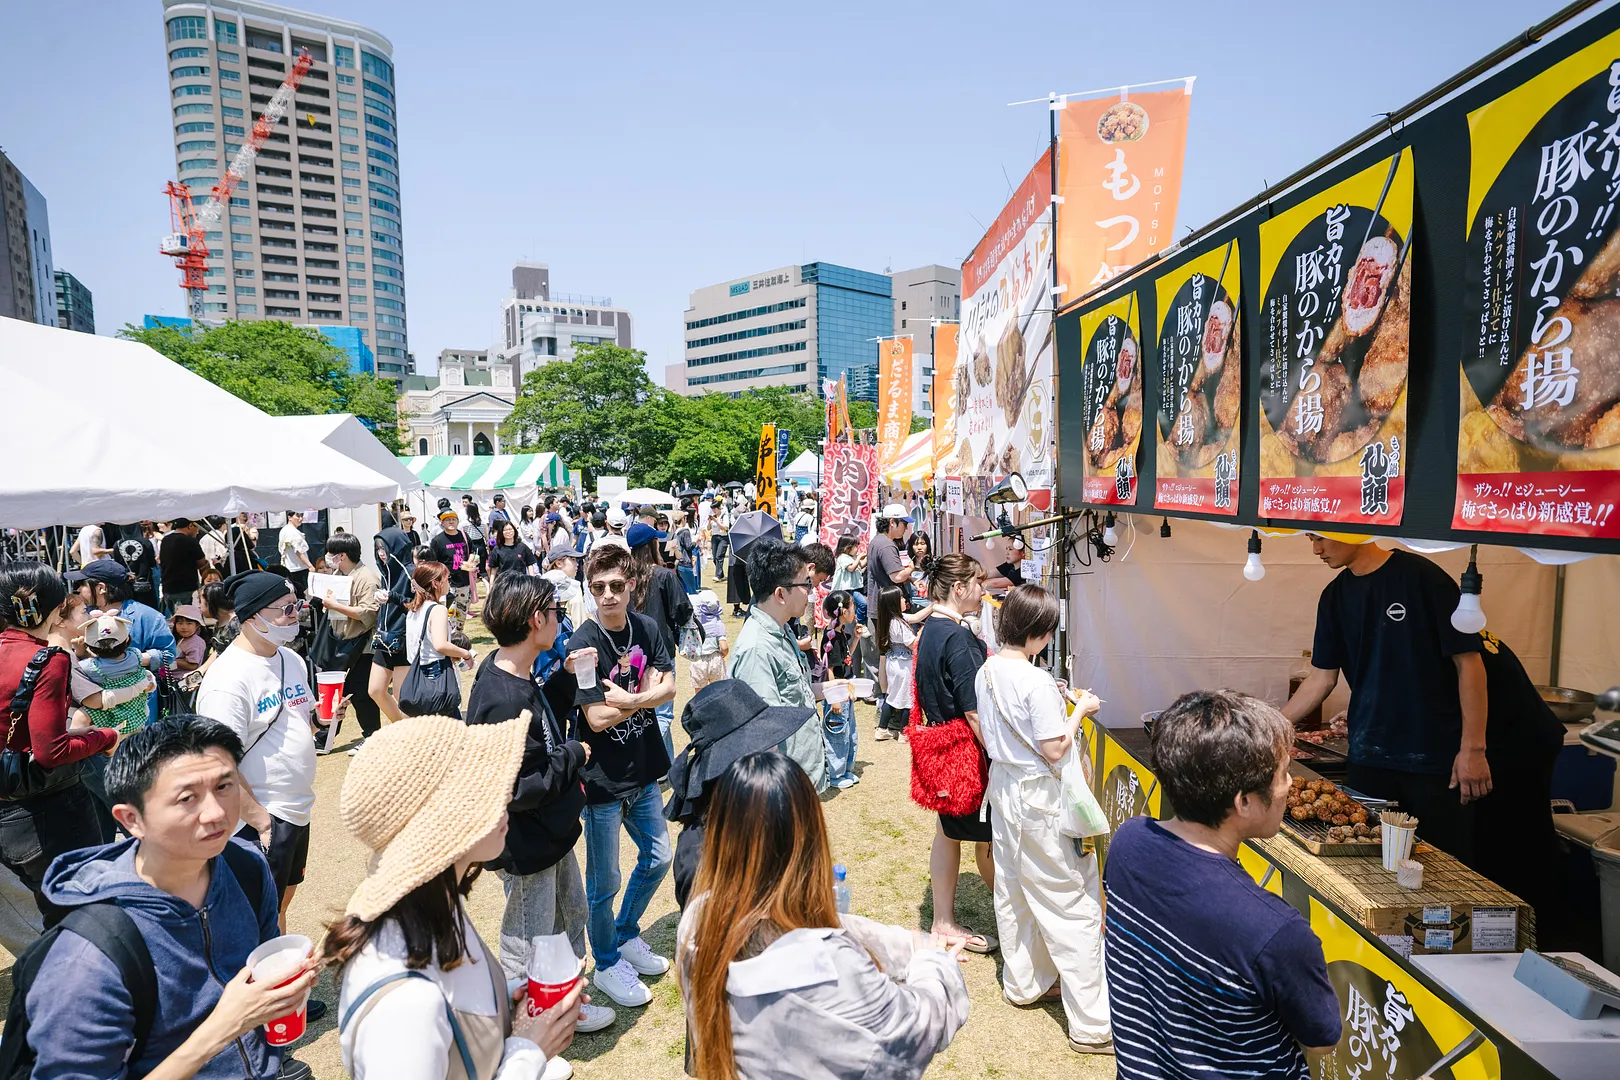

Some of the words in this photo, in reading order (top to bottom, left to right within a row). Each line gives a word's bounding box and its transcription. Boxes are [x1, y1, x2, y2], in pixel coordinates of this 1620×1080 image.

[1323, 204, 1351, 324] 旨カリッ!!
[1488, 213, 1504, 344] ミルフィー仕立てに
[1499, 206, 1517, 366] 自家製醤油ダレに漬け込んだ
[1519, 121, 1599, 411] 豚のから揚
[1176, 302, 1195, 446] 豚のから揚
[1294, 244, 1326, 435] 豚のから揚
[1461, 499, 1615, 527] 梅でさっぱり新感覚!!
[1378, 982, 1415, 1080] 旨カリ
